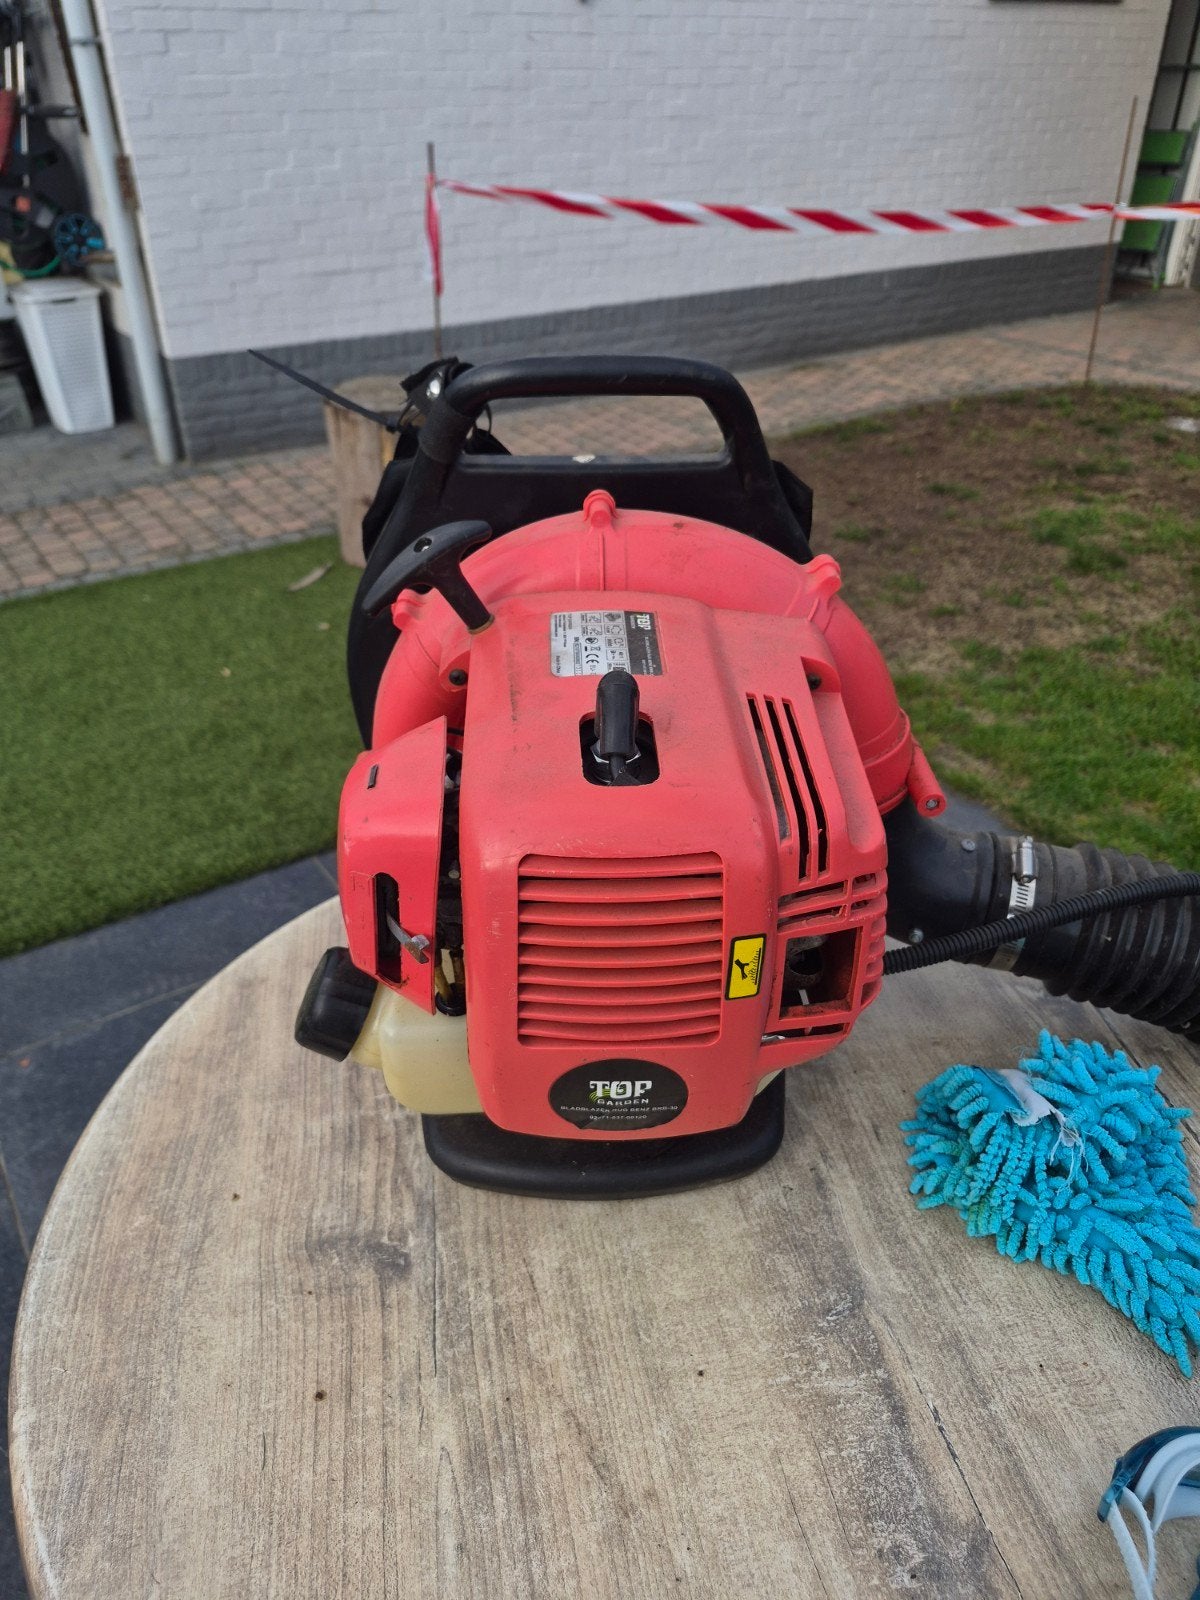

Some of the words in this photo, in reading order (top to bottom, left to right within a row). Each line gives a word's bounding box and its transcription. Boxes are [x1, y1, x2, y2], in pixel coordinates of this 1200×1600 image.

[636, 614, 651, 630] TOP
[589, 1080, 653, 1099] TOP
[597, 1098, 649, 1106] GARDEN
